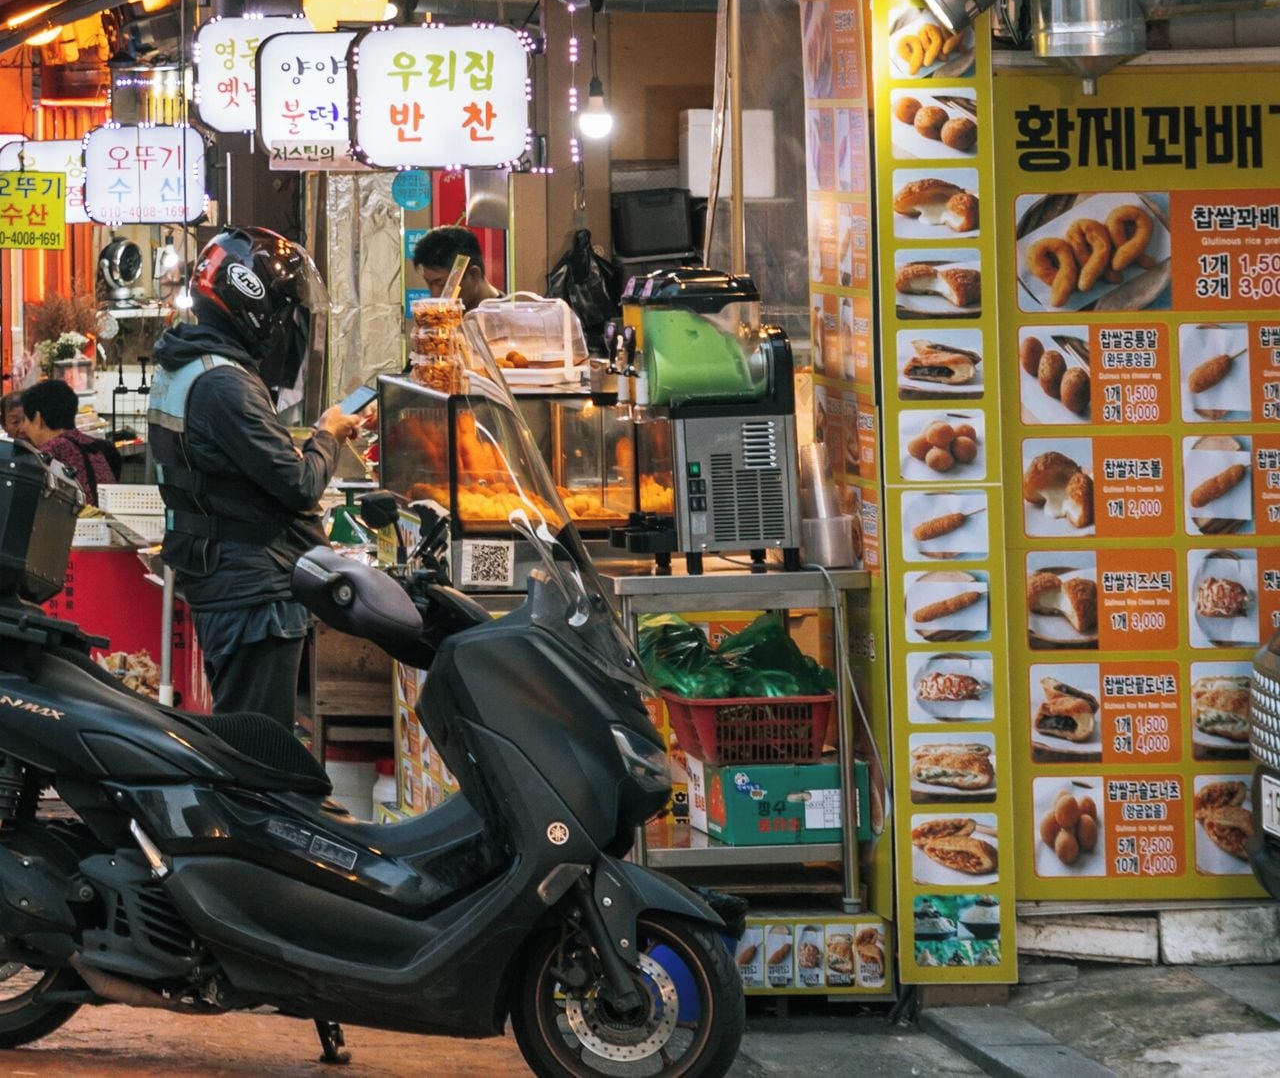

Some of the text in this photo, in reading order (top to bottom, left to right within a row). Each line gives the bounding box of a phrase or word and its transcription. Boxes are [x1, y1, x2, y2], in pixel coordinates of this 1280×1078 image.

[387, 49, 495, 92] 우리집
[281, 99, 349, 135] 불떡
[1015, 104, 1280, 172] 황제꽈배
[108, 145, 182, 171] 오뚜기
[0, 203, 49, 226] 수산
[101, 206, 190, 218] 010-4008-1691
[1199, 253, 1229, 275] 1개
[235, 270, 262, 293] Arai
[1197, 277, 1230, 299] 3개
[1100, 329, 1157, 349] 찹쌀공룡알
[1104, 384, 1156, 403] 1개 1,500
[1104, 404, 1158, 422] 3개 3,000
[1104, 459, 1162, 479] 찹쌀치즈볼
[1107, 500, 1161, 517] 1개 2,000
[1103, 572, 1172, 593] 찹쌀치즈스틱
[1111, 612, 1165, 632] 1개 3,000
[1104, 675, 1176, 696] 찹쌀단팥도너츠
[0, 695, 65, 720] NMAX
[1115, 716, 1168, 735] 1개 1,500
[1114, 735, 1170, 754] 3개 4,000
[1108, 780, 1180, 801] 찹쌀구슬도너츠
[1118, 836, 1173, 855] 5개 2,500
[1115, 857, 1177, 875] 10개 4,000
